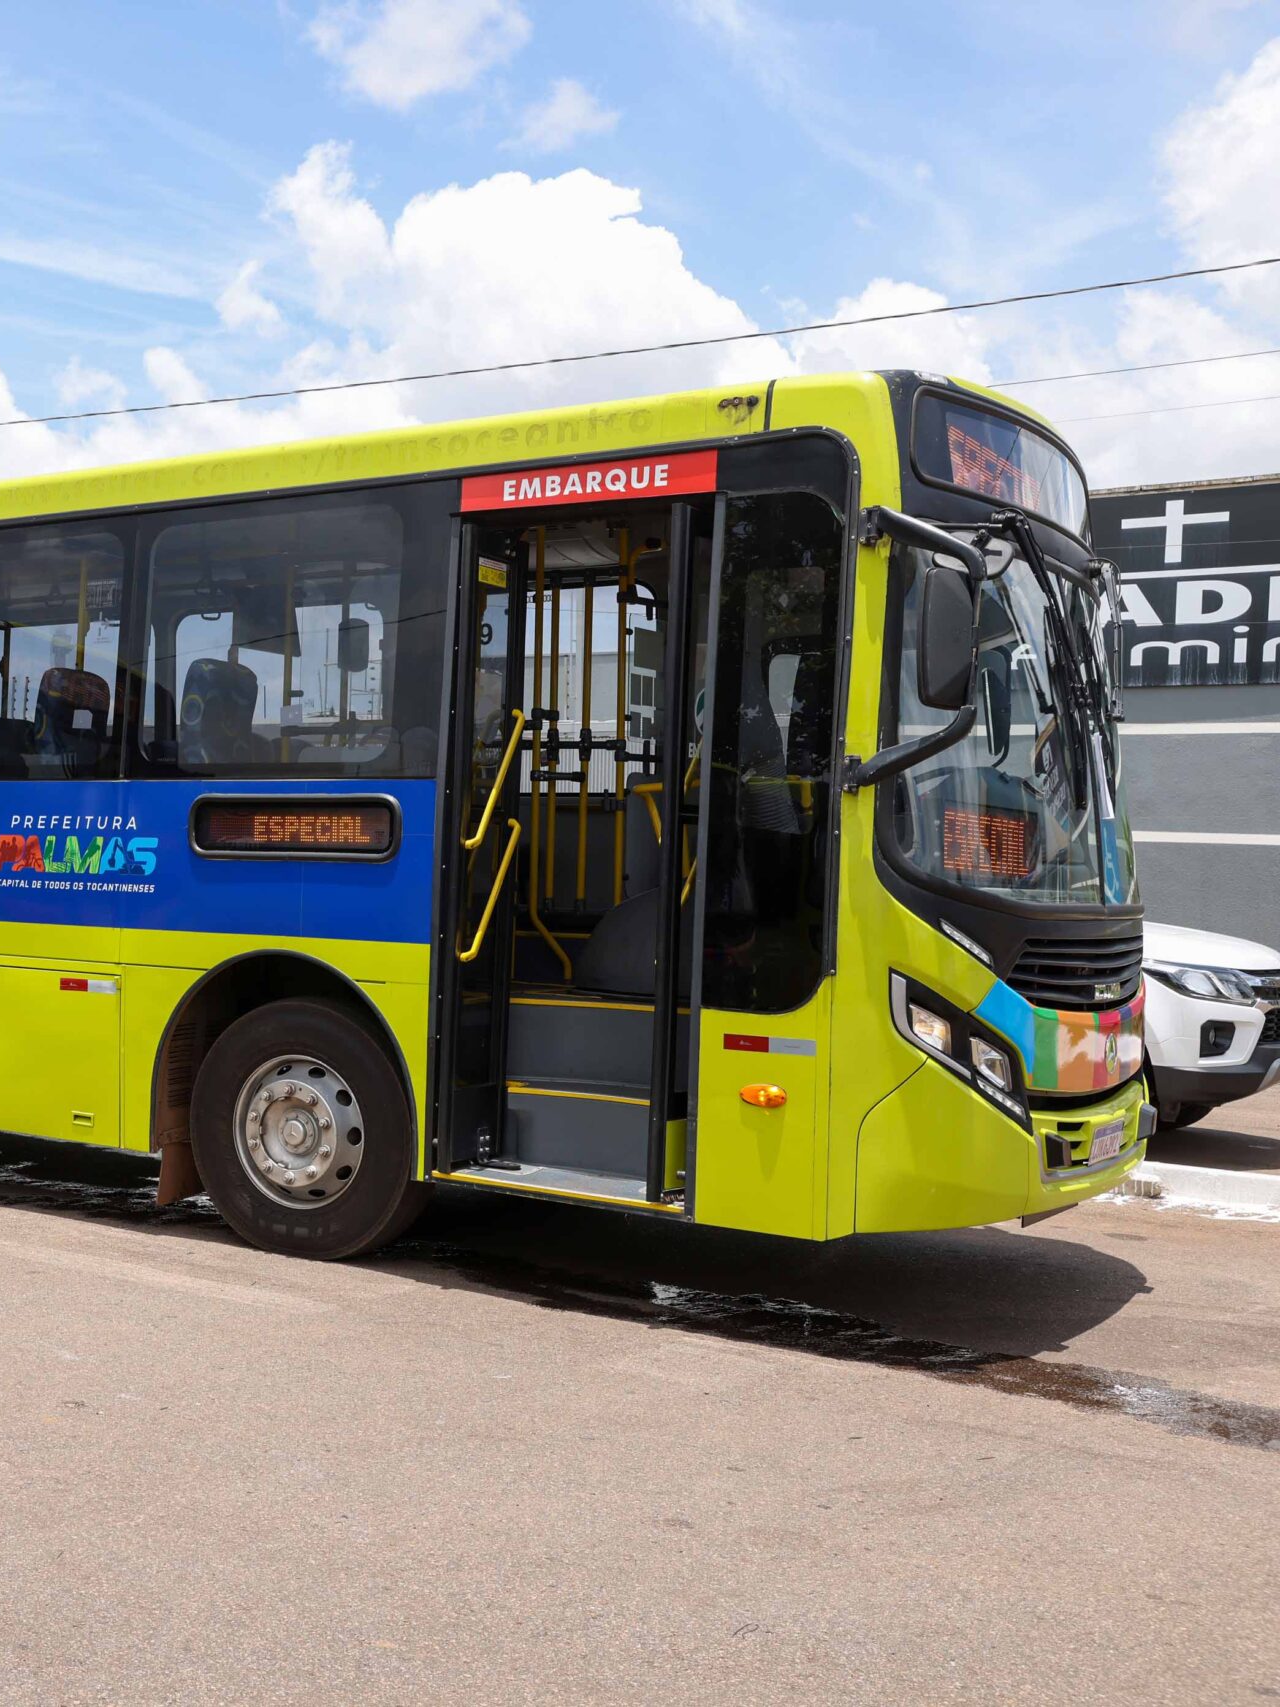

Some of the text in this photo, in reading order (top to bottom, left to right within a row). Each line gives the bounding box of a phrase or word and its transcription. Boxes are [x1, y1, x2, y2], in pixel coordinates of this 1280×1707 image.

[501, 463, 670, 502] EMBARQUE
[1100, 575, 1280, 627] AD
[10, 815, 137, 830] PREFEITURA
[254, 815, 371, 843] ESPECIAL
[31, 880, 42, 889] DE
[44, 880, 70, 890] TODOS
[73, 882, 84, 891] OS
[86, 883, 156, 893] TOCANTINENSES
